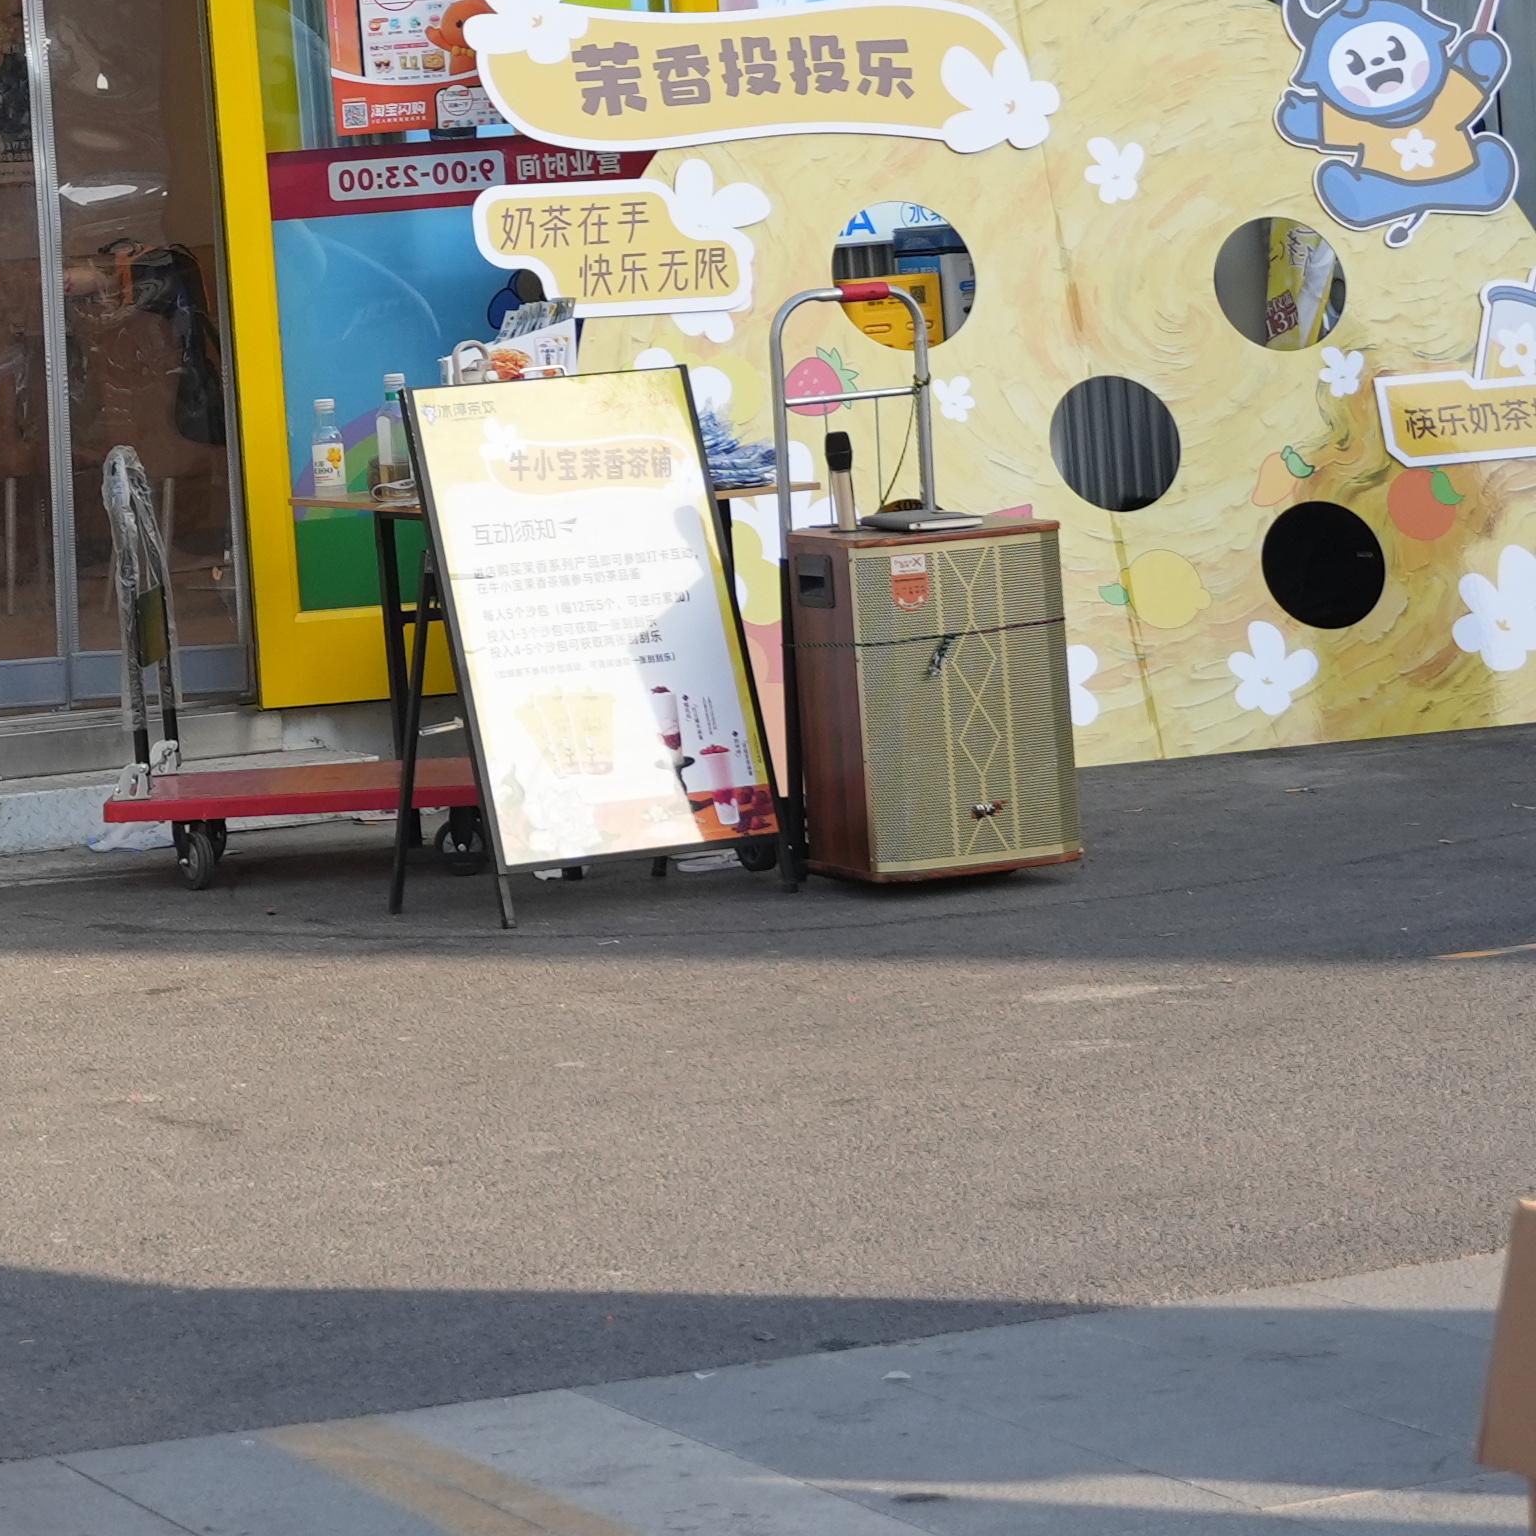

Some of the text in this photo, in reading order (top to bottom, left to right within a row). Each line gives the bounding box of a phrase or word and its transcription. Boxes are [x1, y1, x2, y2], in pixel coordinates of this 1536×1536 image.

[571, 35, 916, 116] 茉香投投乐
[371, 101, 426, 117] 淘宝闪购
[501, 201, 650, 250] 奶茶在手
[579, 247, 730, 297] 快乐无限
[1404, 398, 1536, 441] 筷乐奶茶
[509, 446, 672, 482] 牛小宝茉香茶铺
[472, 518, 556, 546] 互动须知
